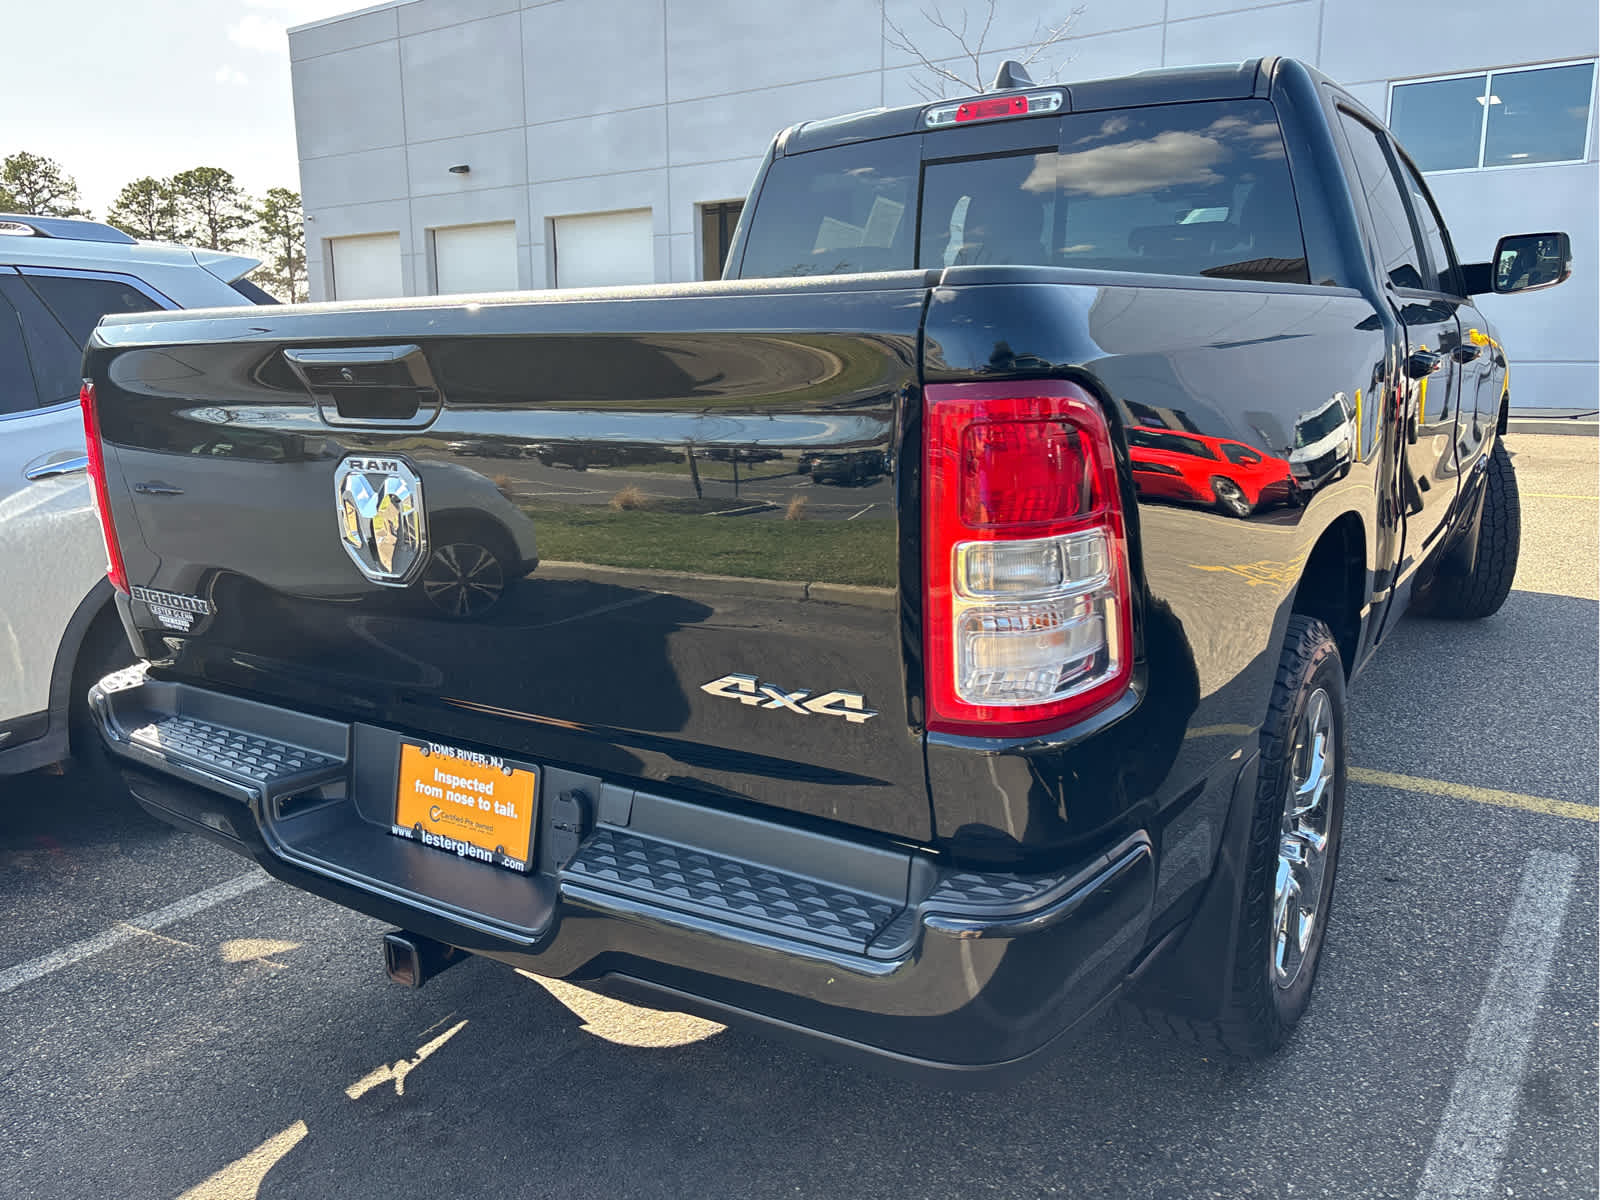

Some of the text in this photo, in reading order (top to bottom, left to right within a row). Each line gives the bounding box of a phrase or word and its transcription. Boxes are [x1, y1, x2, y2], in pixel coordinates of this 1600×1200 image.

[349, 460, 398, 472] RAM
[130, 586, 210, 615] BIGHORN
[700, 672, 878, 723] 4x4
[428, 742, 504, 769] TOMS RIVER, NJ
[434, 768, 494, 796] Inspected
[415, 780, 519, 819] from nose to tail.
[391, 825, 525, 872] www. lesterglenn .com
